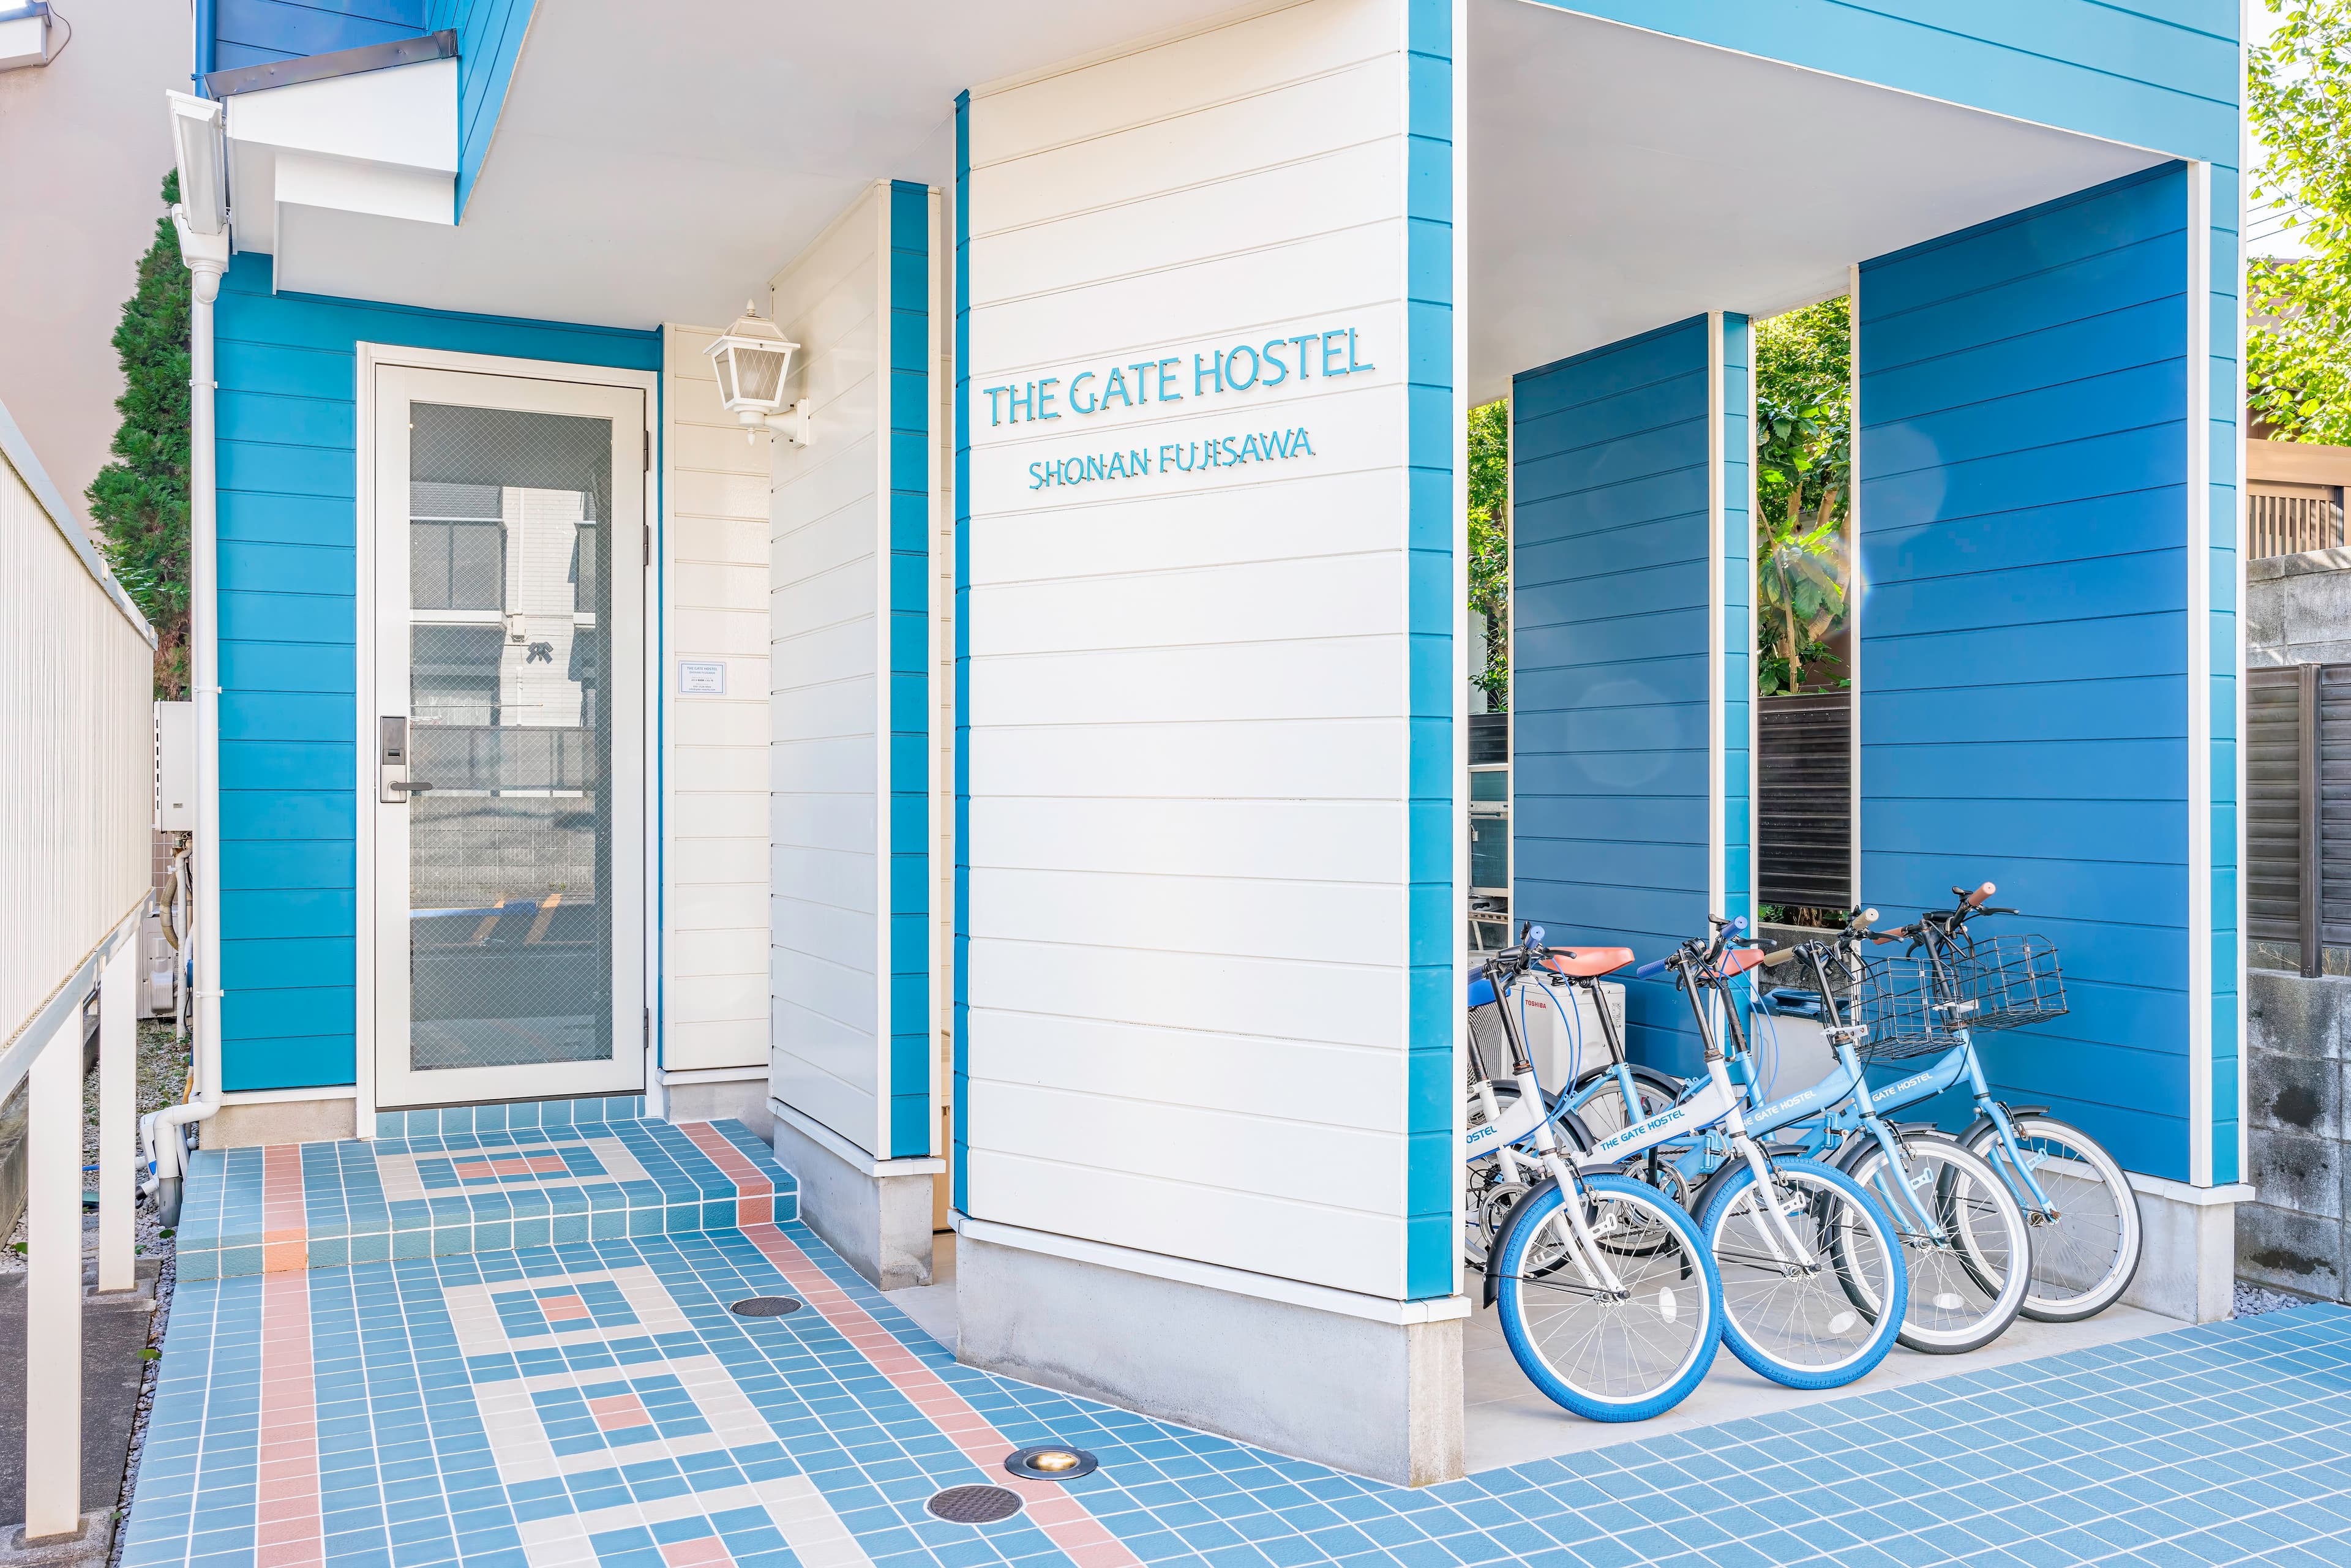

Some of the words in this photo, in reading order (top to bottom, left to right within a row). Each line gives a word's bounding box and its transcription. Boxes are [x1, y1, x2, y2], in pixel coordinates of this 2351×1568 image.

[983, 377, 1059, 426] THE
[1069, 357, 1182, 415] GATE
[1194, 328, 1374, 396] HOSTEL
[1029, 448, 1149, 489] SHONAN
[1160, 427, 1314, 473] FUJISAWA
[1525, 999, 1547, 1009] TOSHIBA
[1872, 1087, 1895, 1102] GATE
[1897, 1073, 1933, 1092] HOSTEL
[1755, 1106, 1779, 1122] GATE
[1780, 1090, 1817, 1111] HOSTEL
[1467, 1126, 1497, 1144] OSTEL
[1600, 1137, 1619, 1151] THE
[1621, 1126, 1646, 1142] GATE
[1648, 1109, 1685, 1130] HOSTEL
